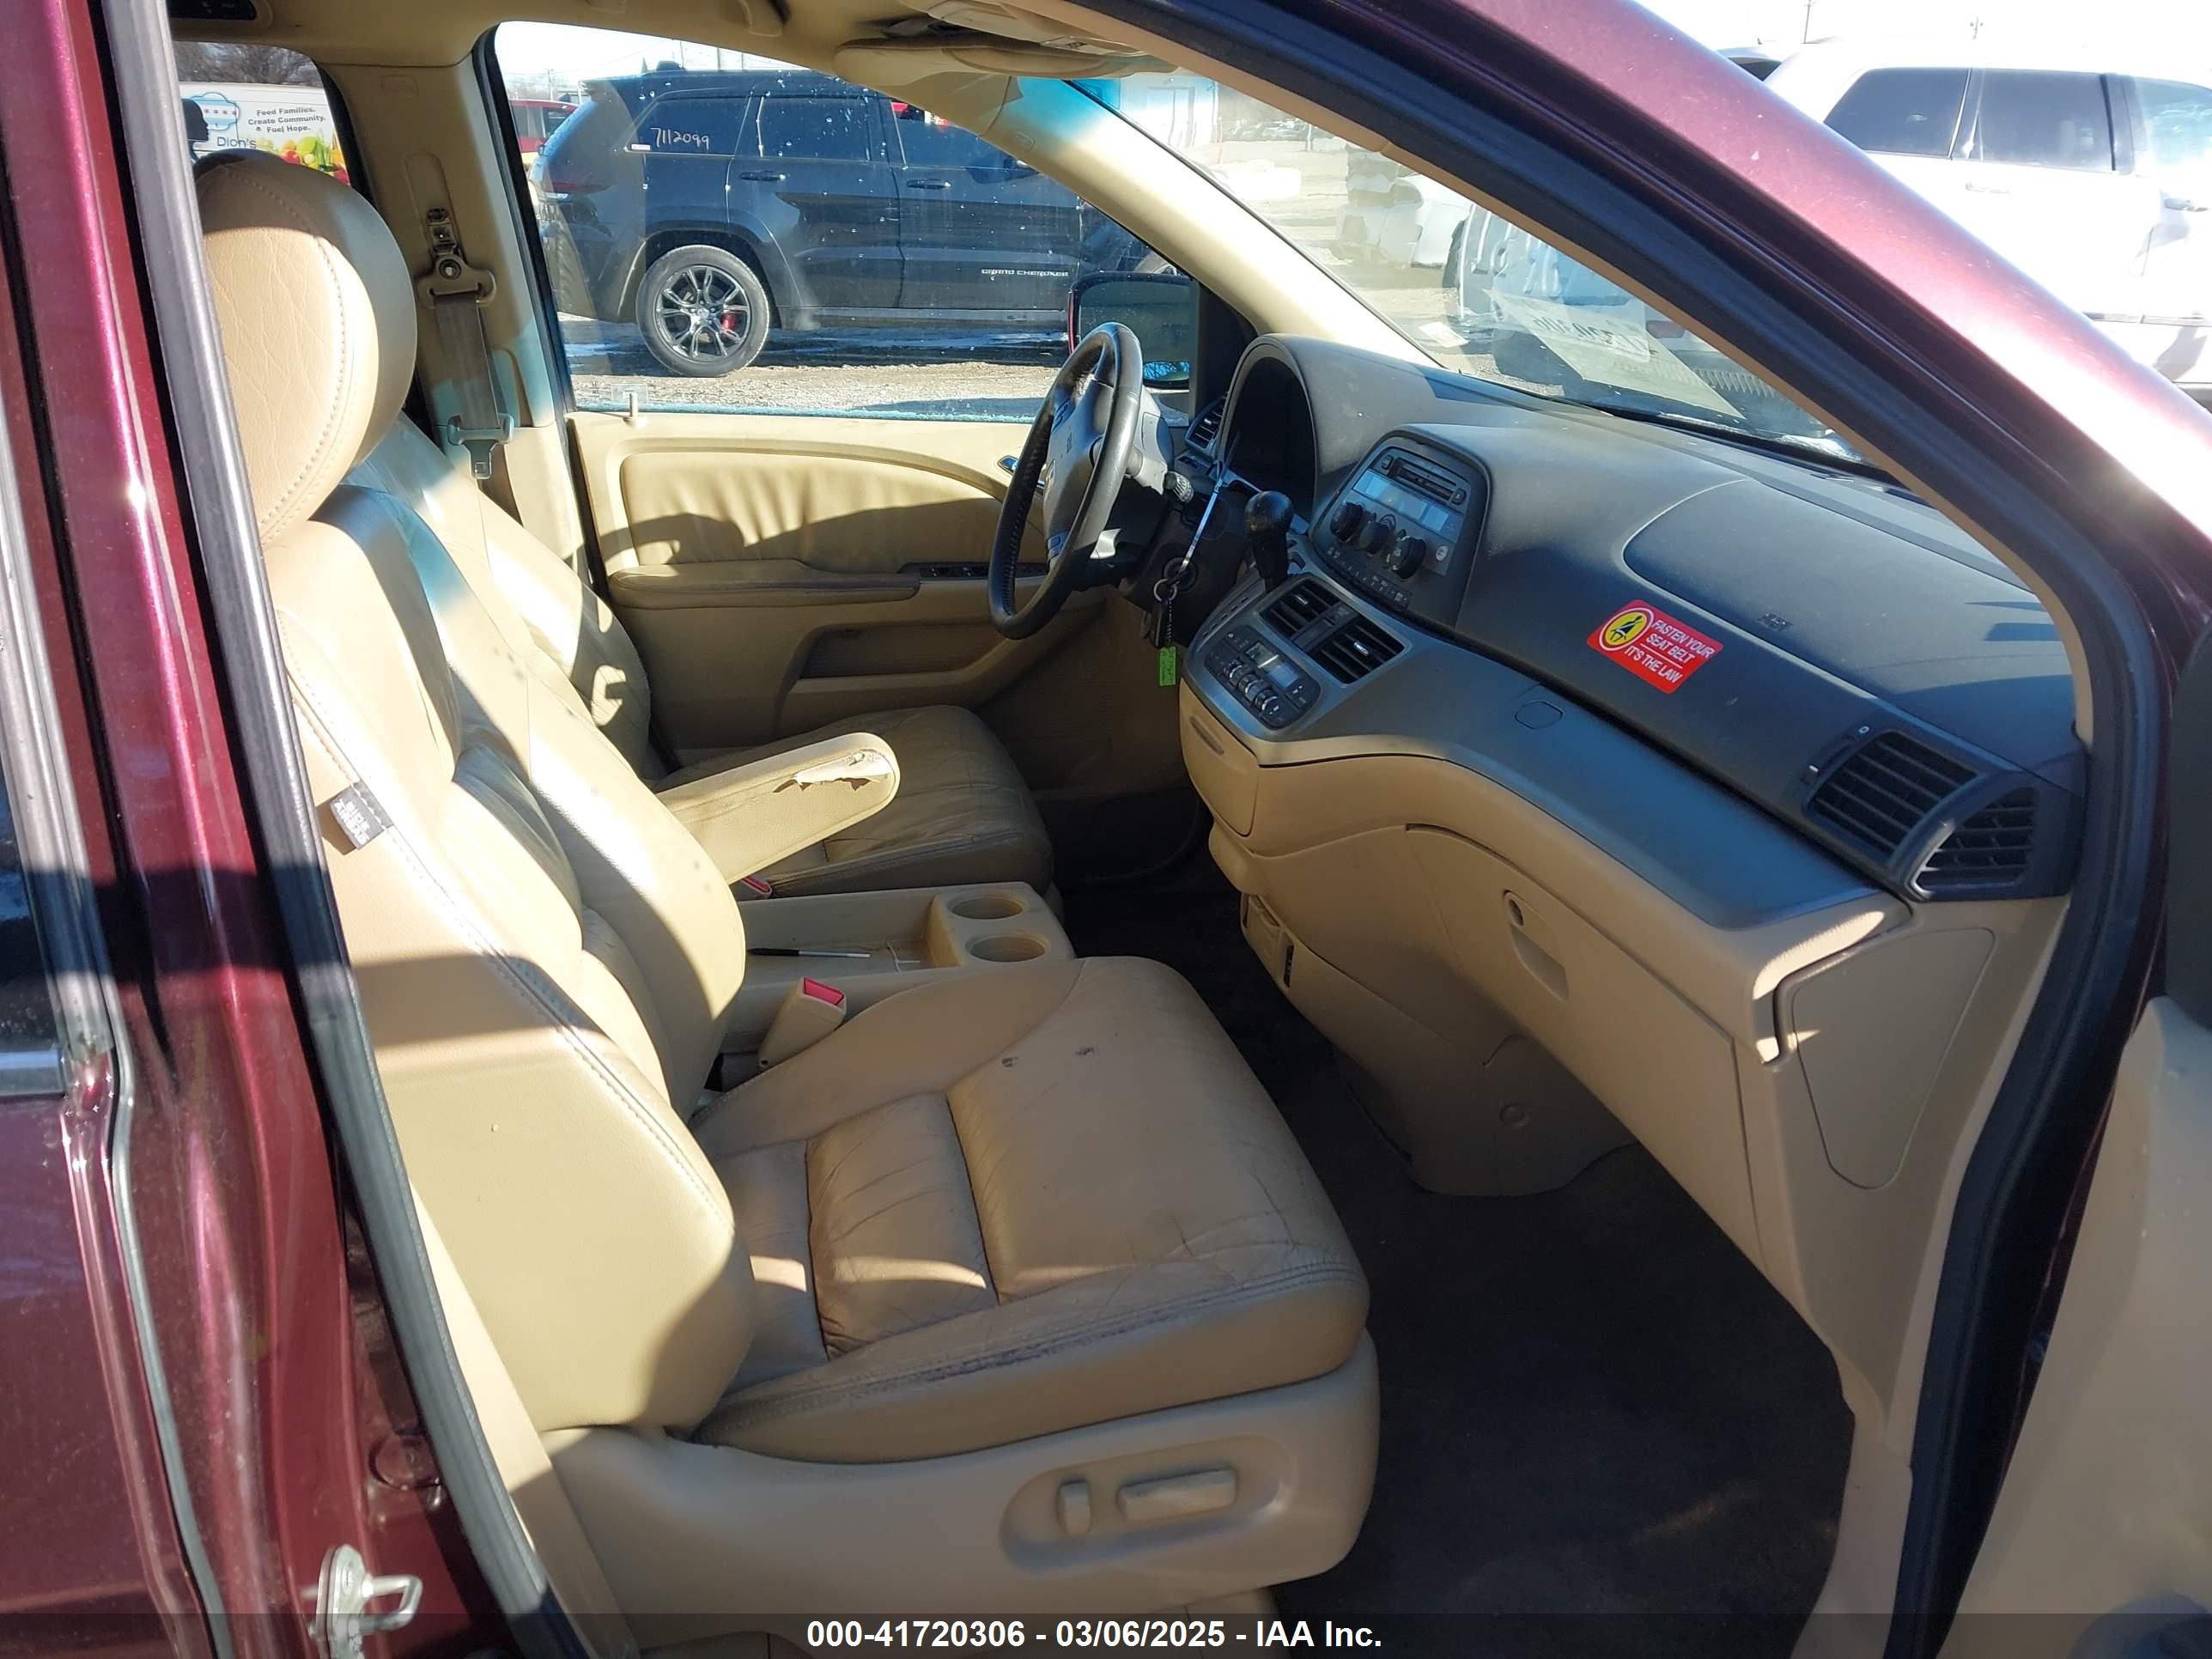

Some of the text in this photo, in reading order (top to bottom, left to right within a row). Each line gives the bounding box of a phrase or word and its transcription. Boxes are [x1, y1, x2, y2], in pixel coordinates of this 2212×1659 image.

[278, 115, 326, 124] Community.
[216, 137, 257, 149] Dion's
[649, 127, 709, 152] 7112099
[1645, 633, 1695, 664] SEAT BELT
[1651, 619, 1716, 659] FASTEN YOUR
[1624, 645, 1683, 684] IT'S THE LAW
